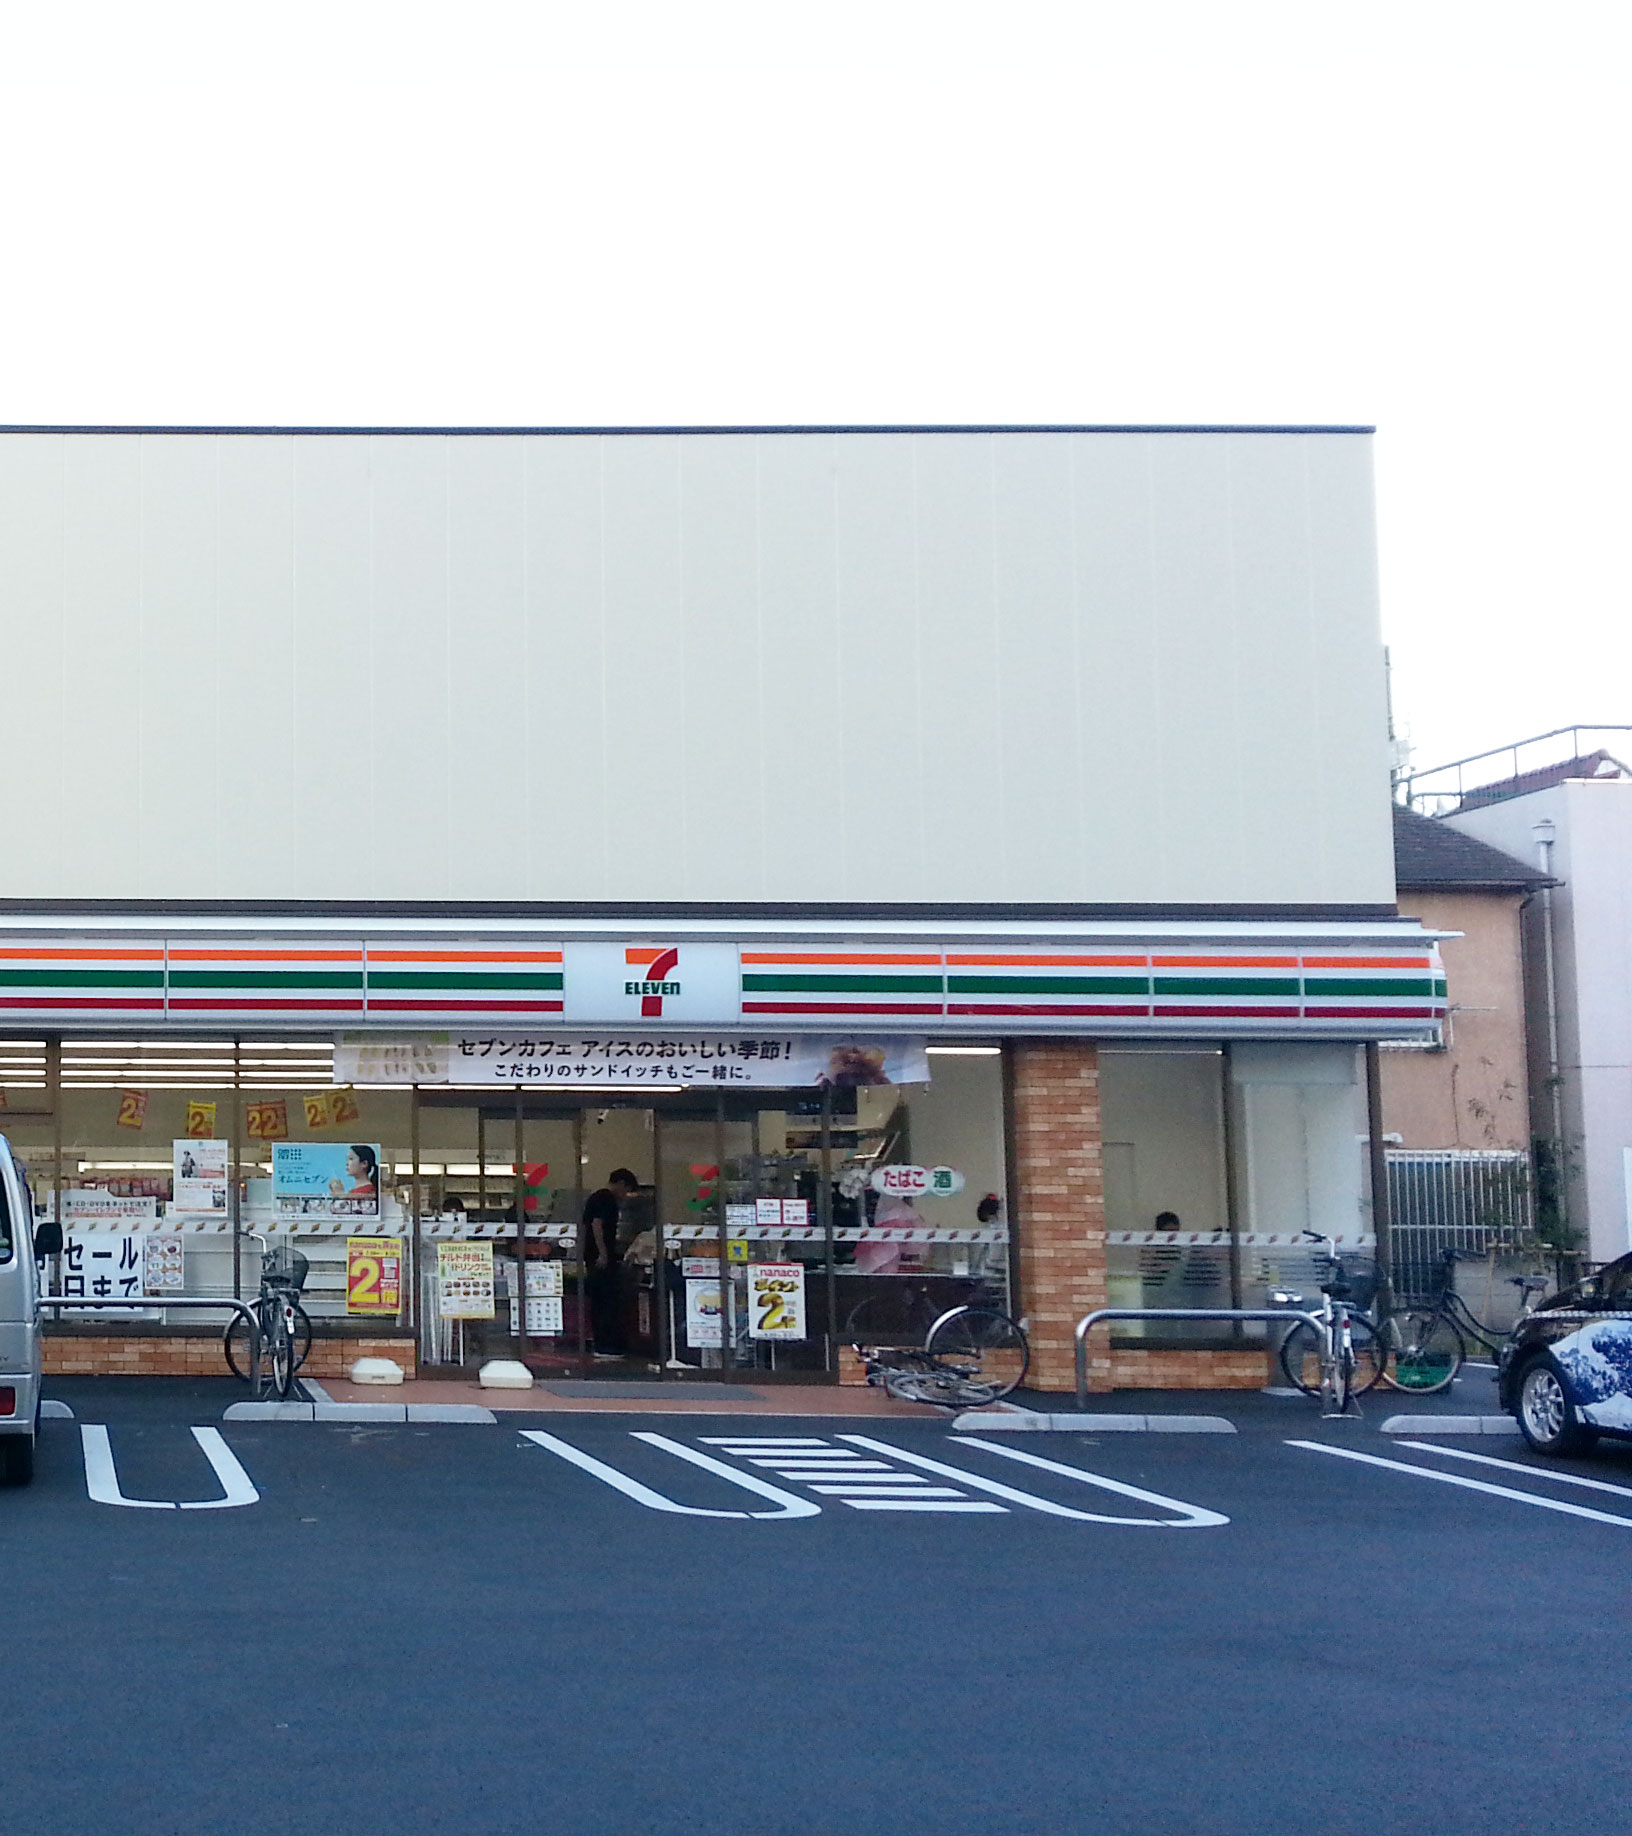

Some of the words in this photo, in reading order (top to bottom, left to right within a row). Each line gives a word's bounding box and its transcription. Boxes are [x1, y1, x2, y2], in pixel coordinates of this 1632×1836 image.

[457, 1039, 572, 1058] セブンカフェ
[581, 1039, 792, 1060] アイスのおいしい季節!
[494, 1063, 753, 1081] こだわりのサンドイッチもご一緒に。
[279, 1174, 329, 1184] オムニセブン
[883, 1169, 926, 1188] たばこ
[933, 1170, 952, 1188] 酒
[40, 1236, 139, 1271] セール
[351, 1256, 380, 1303] 2
[760, 1269, 800, 1278] nanaco
